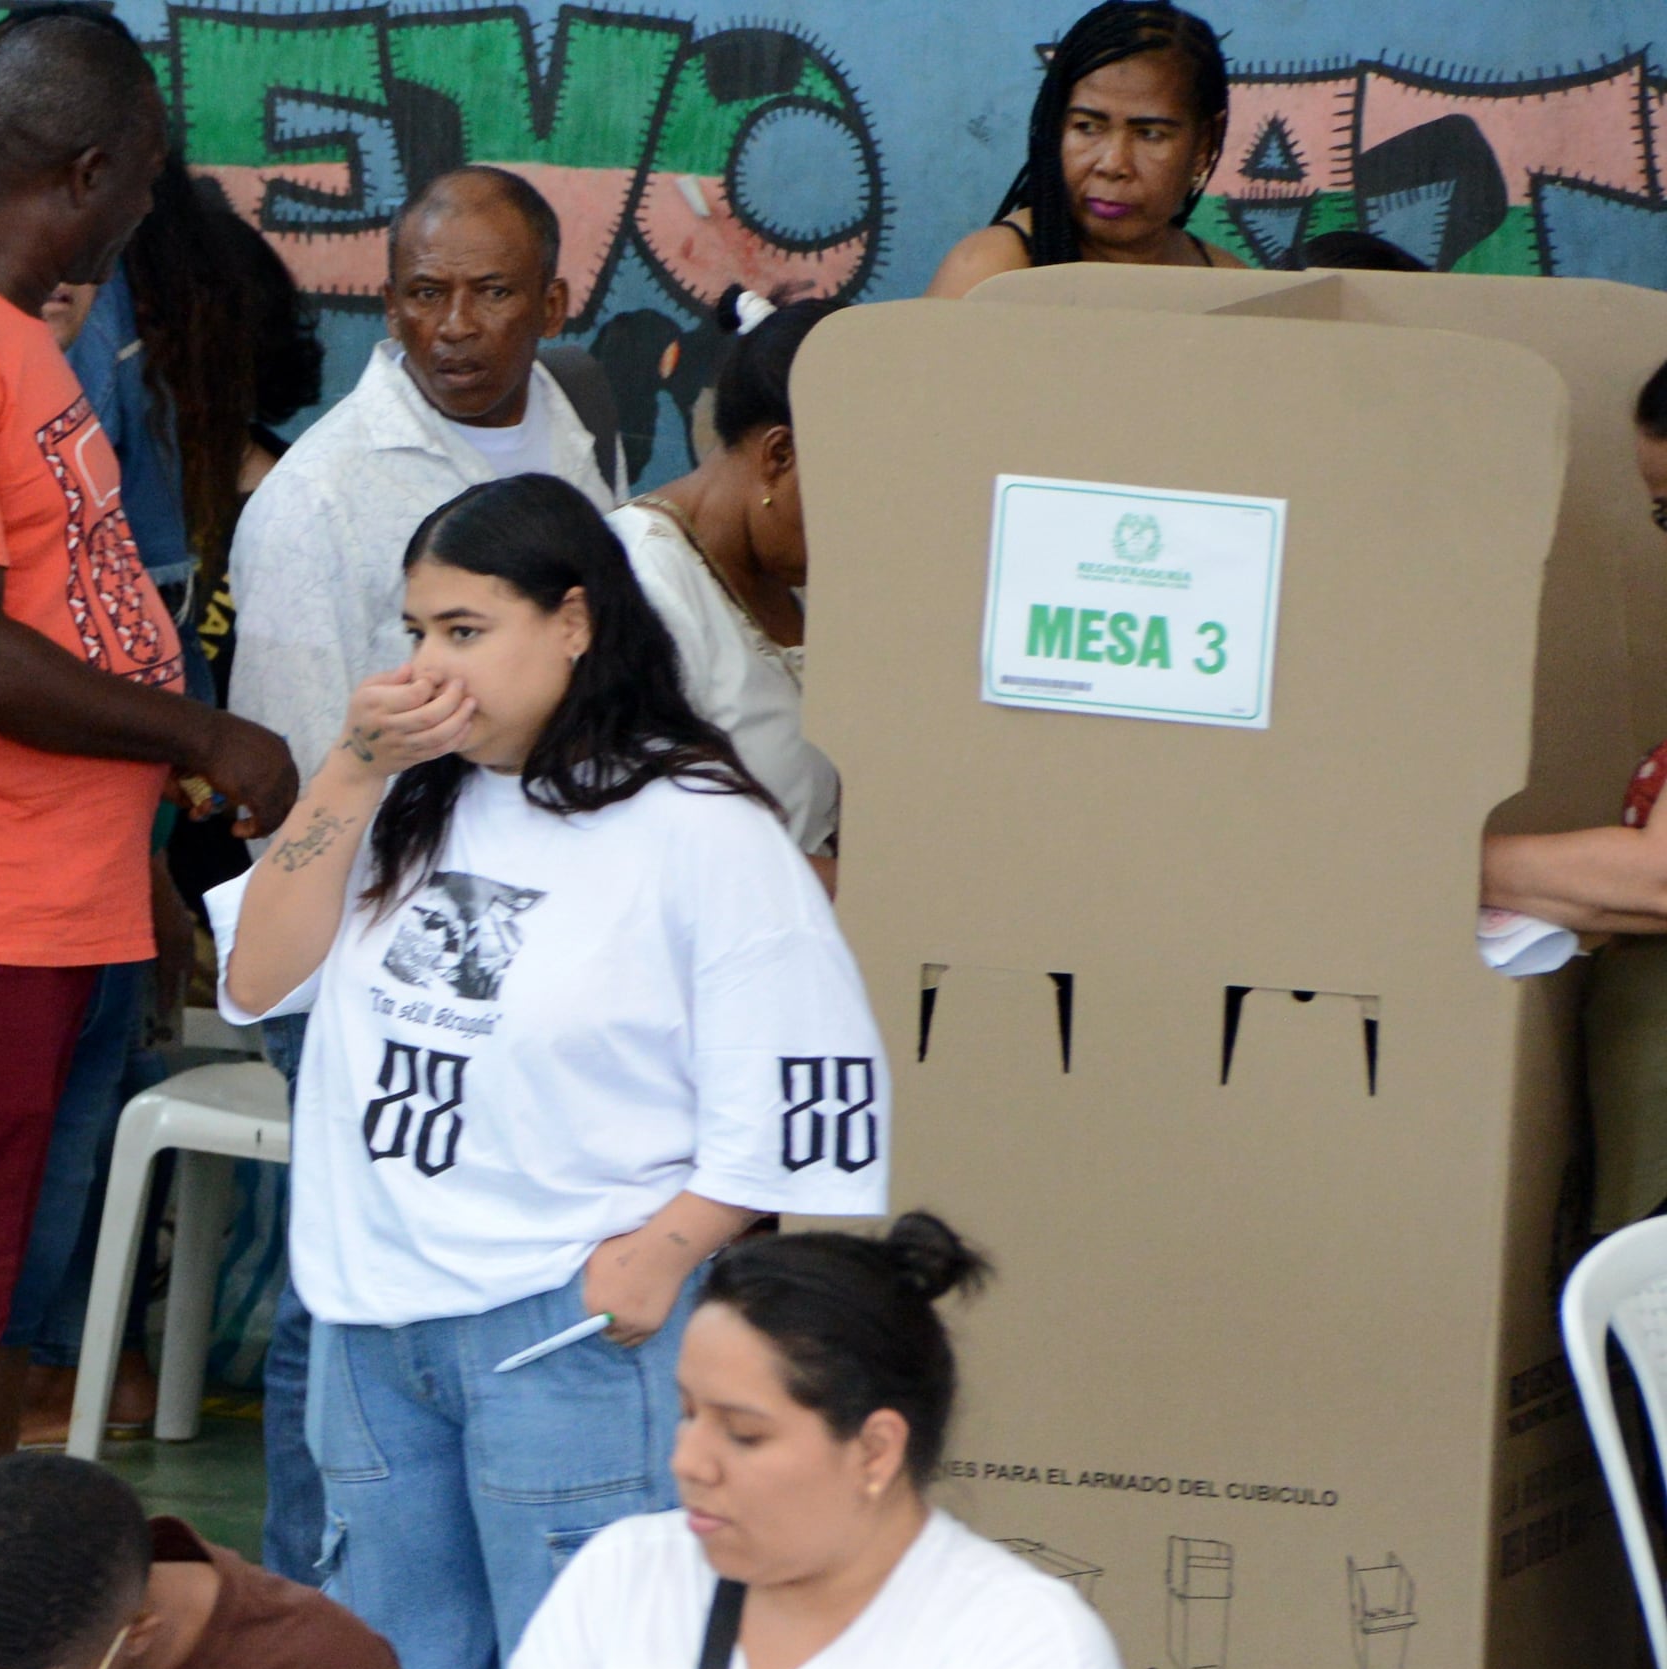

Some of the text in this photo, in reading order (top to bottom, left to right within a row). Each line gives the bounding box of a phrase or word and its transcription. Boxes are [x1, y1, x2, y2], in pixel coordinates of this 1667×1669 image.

[1024, 603, 1228, 675] MESA 3
[986, 1461, 1041, 1484] PARA
[1048, 1467, 1072, 1486] EL
[1078, 1470, 1172, 1494] ARMADO
[1179, 1477, 1219, 1498] DEL
